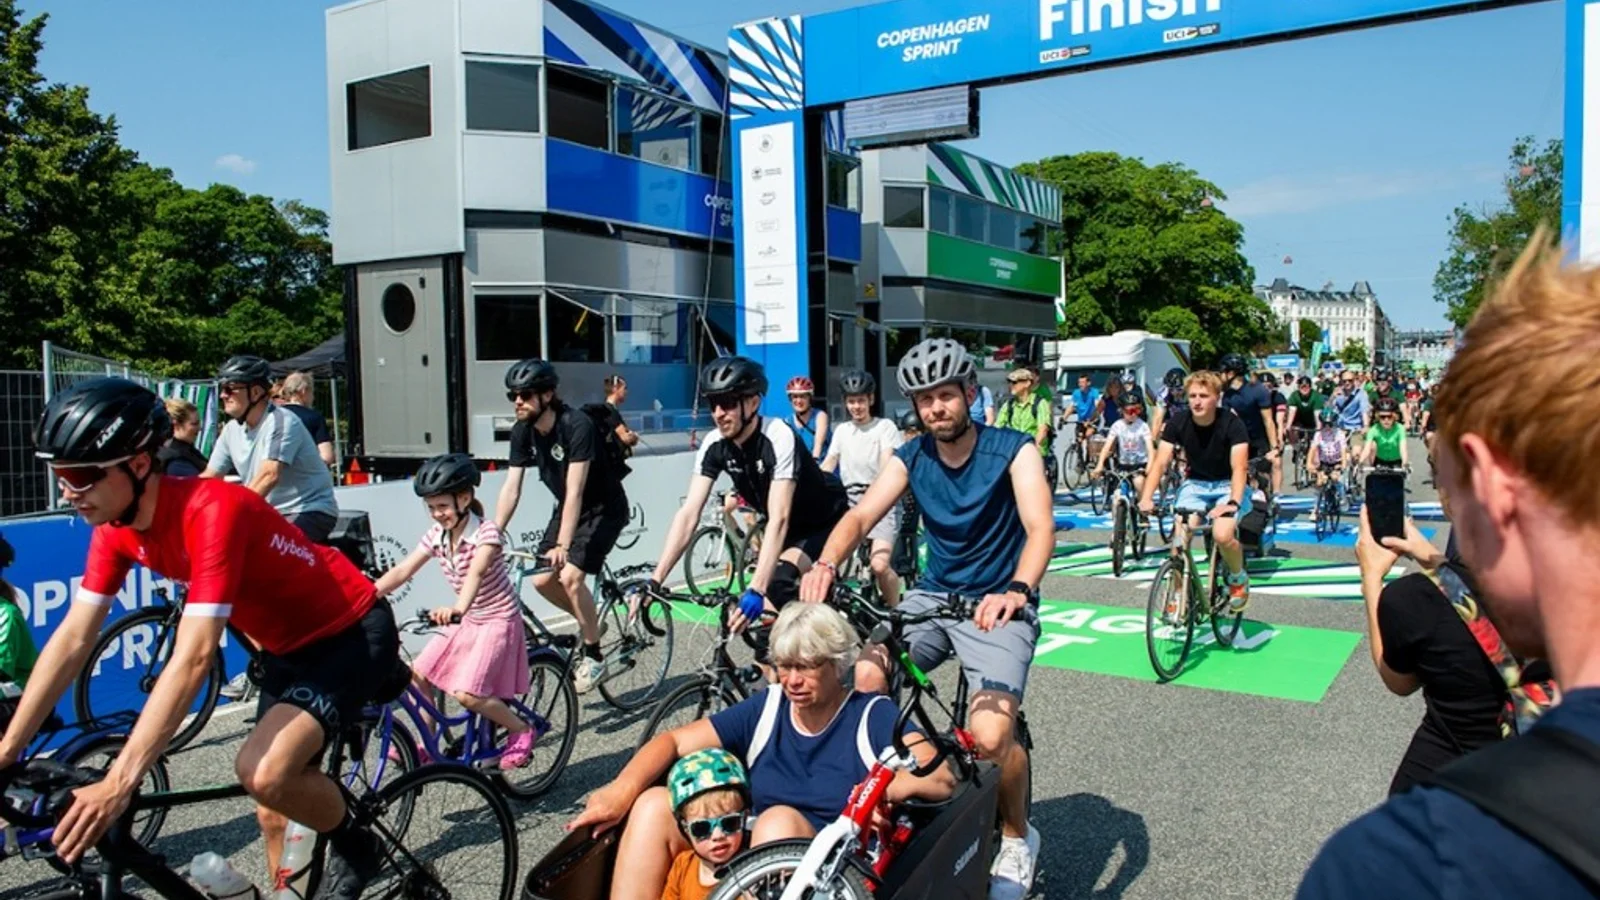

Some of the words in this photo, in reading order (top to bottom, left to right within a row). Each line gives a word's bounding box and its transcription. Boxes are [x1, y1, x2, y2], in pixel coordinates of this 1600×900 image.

[877, 14, 990, 48] COPENHAGEN
[1166, 31, 1186, 40] UCI
[902, 38, 962, 62] SPRINT
[1042, 51, 1060, 61] UCI
